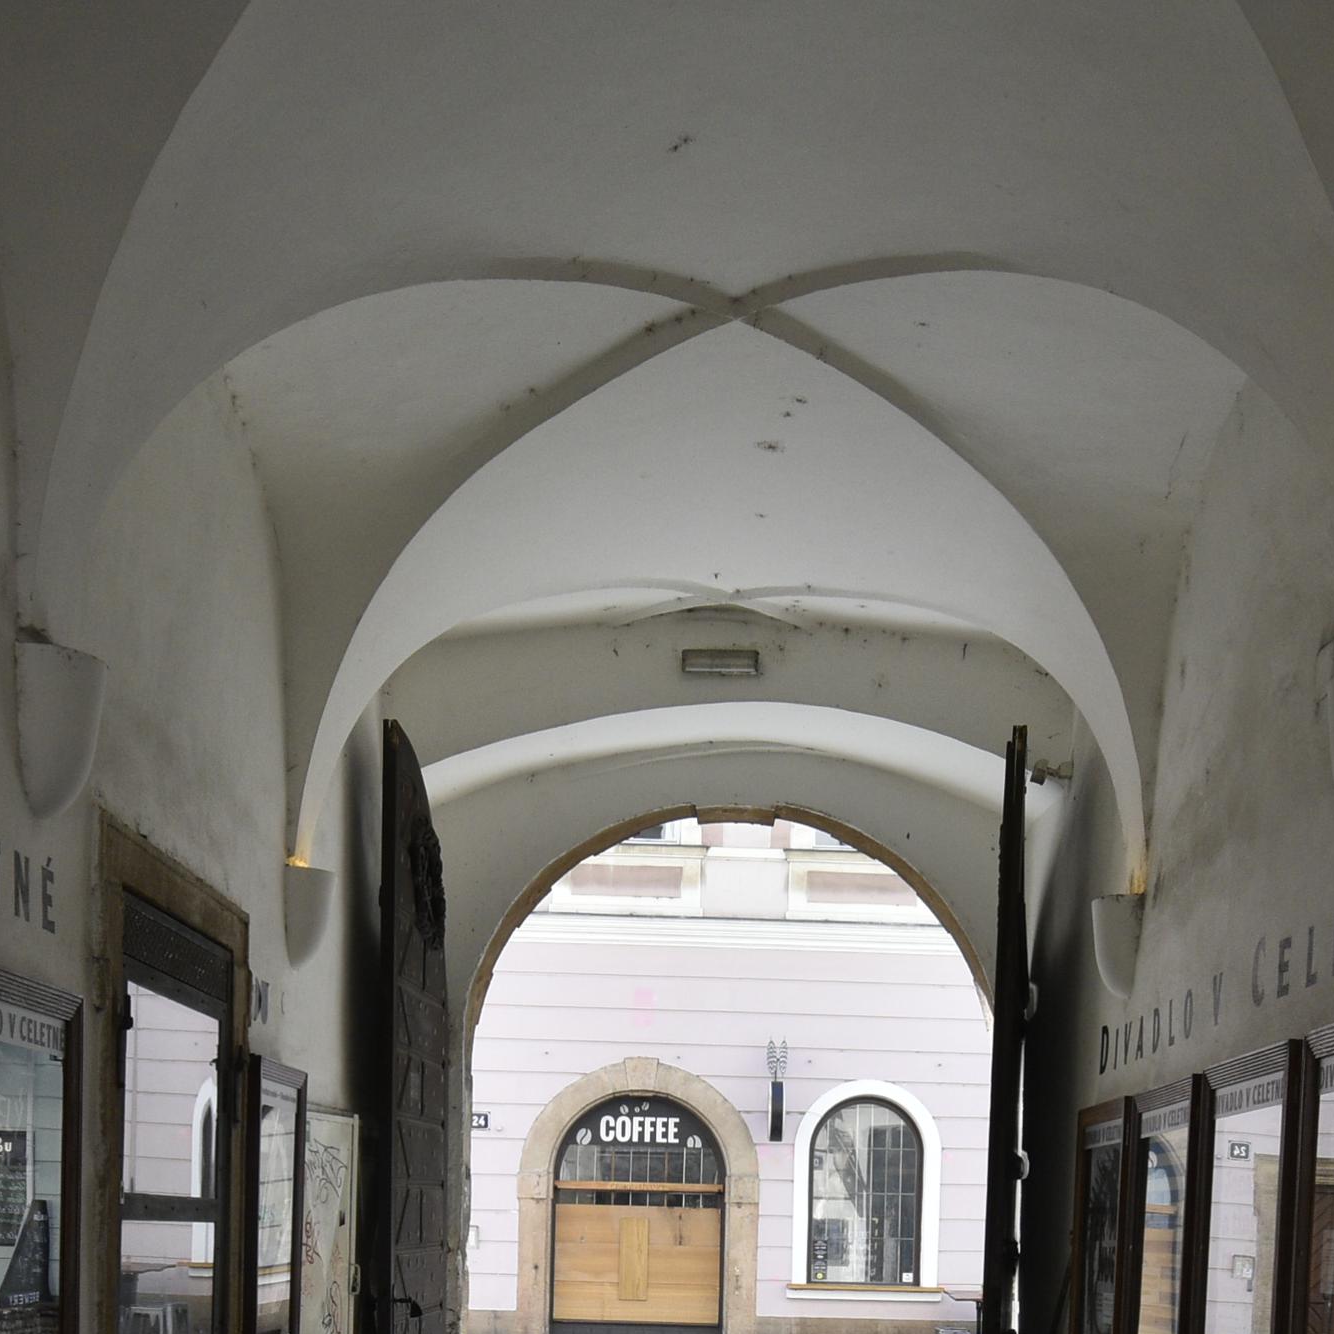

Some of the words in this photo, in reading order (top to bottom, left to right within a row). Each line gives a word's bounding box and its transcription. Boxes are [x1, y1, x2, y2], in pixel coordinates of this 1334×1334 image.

[8, 1013, 16, 1039] V
[1099, 989, 1194, 1076] DIVADLO
[1212, 971, 1223, 1026] V
[471, 1115, 485, 1127] 24
[599, 1115, 680, 1143] COFFEE
